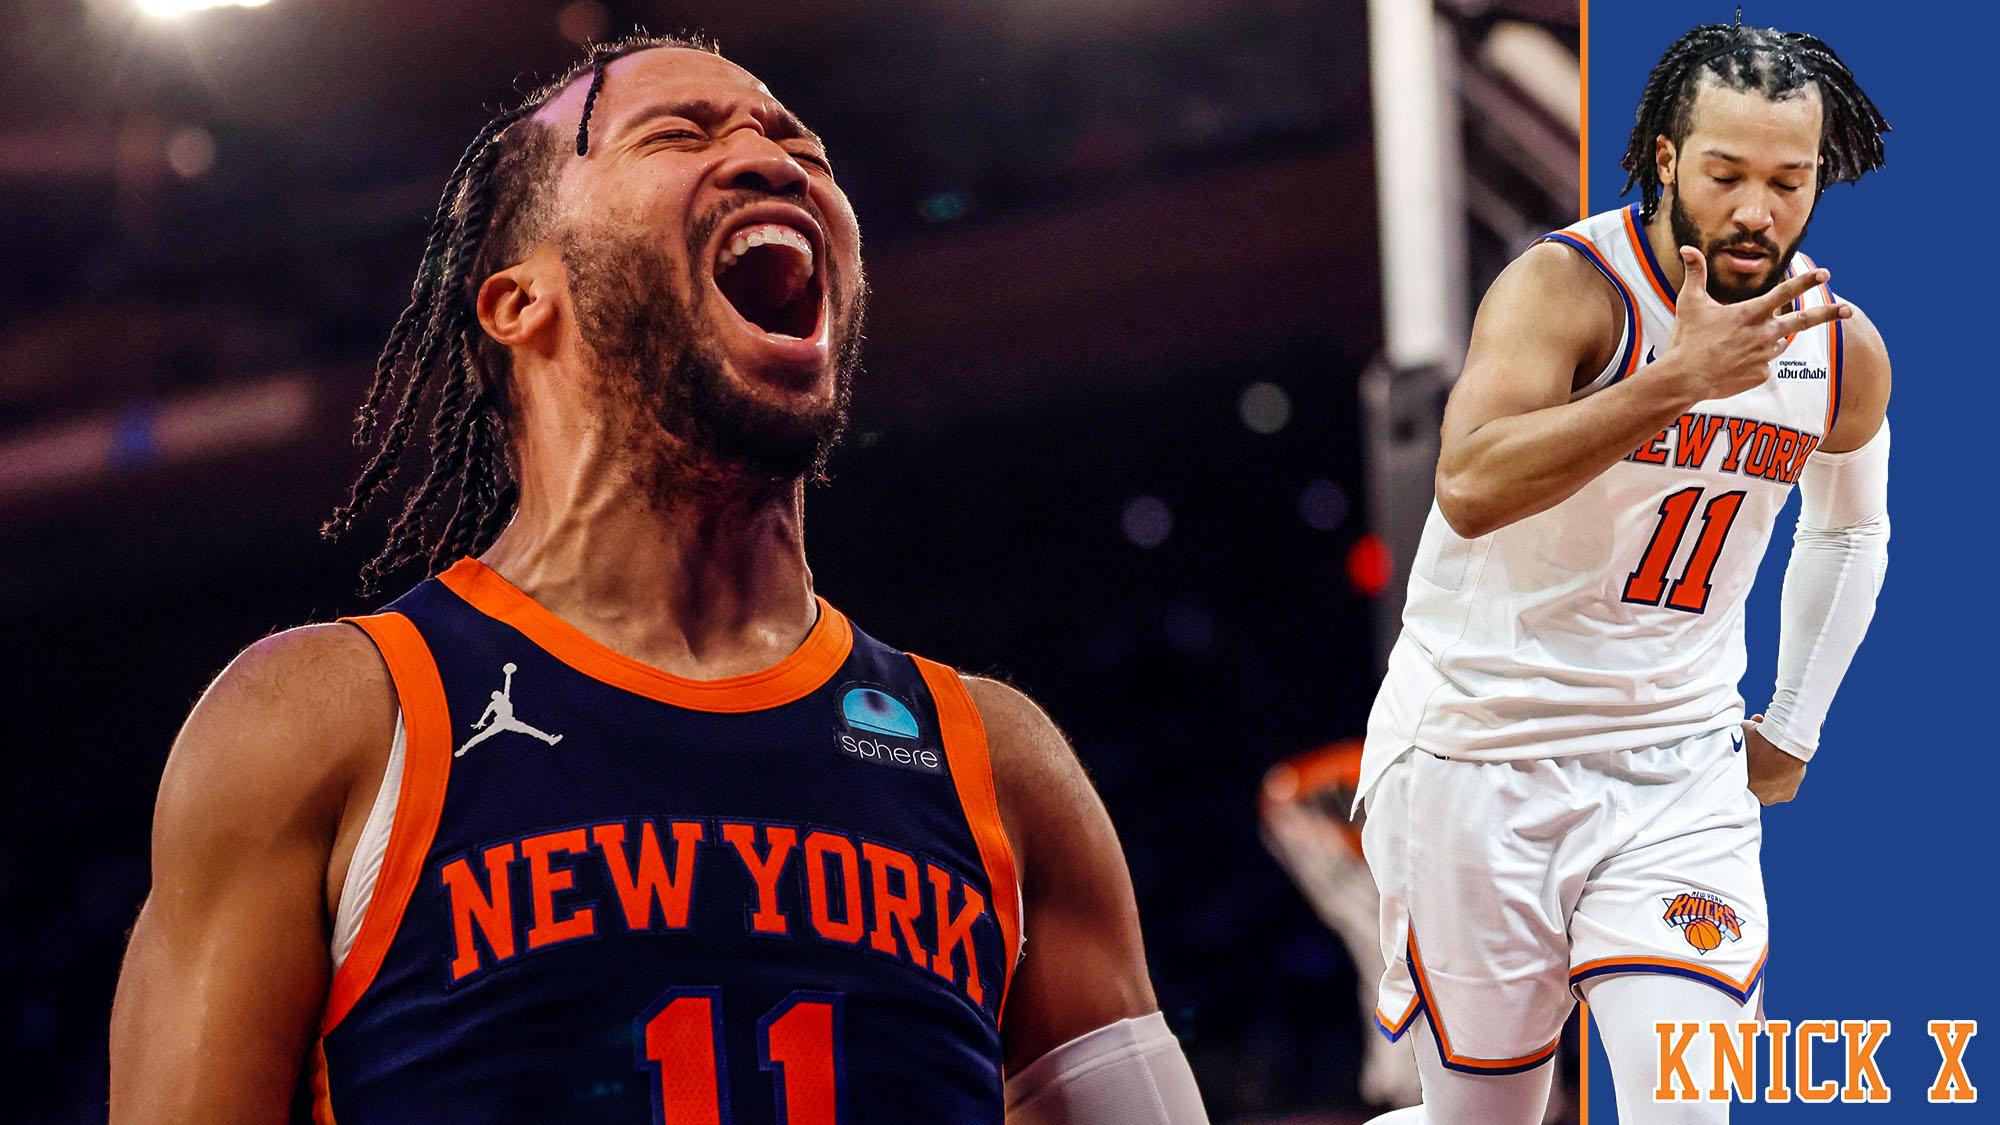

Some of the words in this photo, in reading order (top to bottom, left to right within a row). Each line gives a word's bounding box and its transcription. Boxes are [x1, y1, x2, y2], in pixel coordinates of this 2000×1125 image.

[1777, 367, 1798, 379] abu
[1799, 366, 1828, 379] dhabi
[1624, 413, 1724, 469] EW
[1719, 416, 1820, 485] YORK
[1621, 486, 1747, 614] 11
[841, 735, 938, 768] sphere
[437, 817, 706, 987] NEW
[719, 820, 992, 1013] YORK
[1663, 893, 1741, 941] KNICKS
[635, 986, 843, 1125] 11
